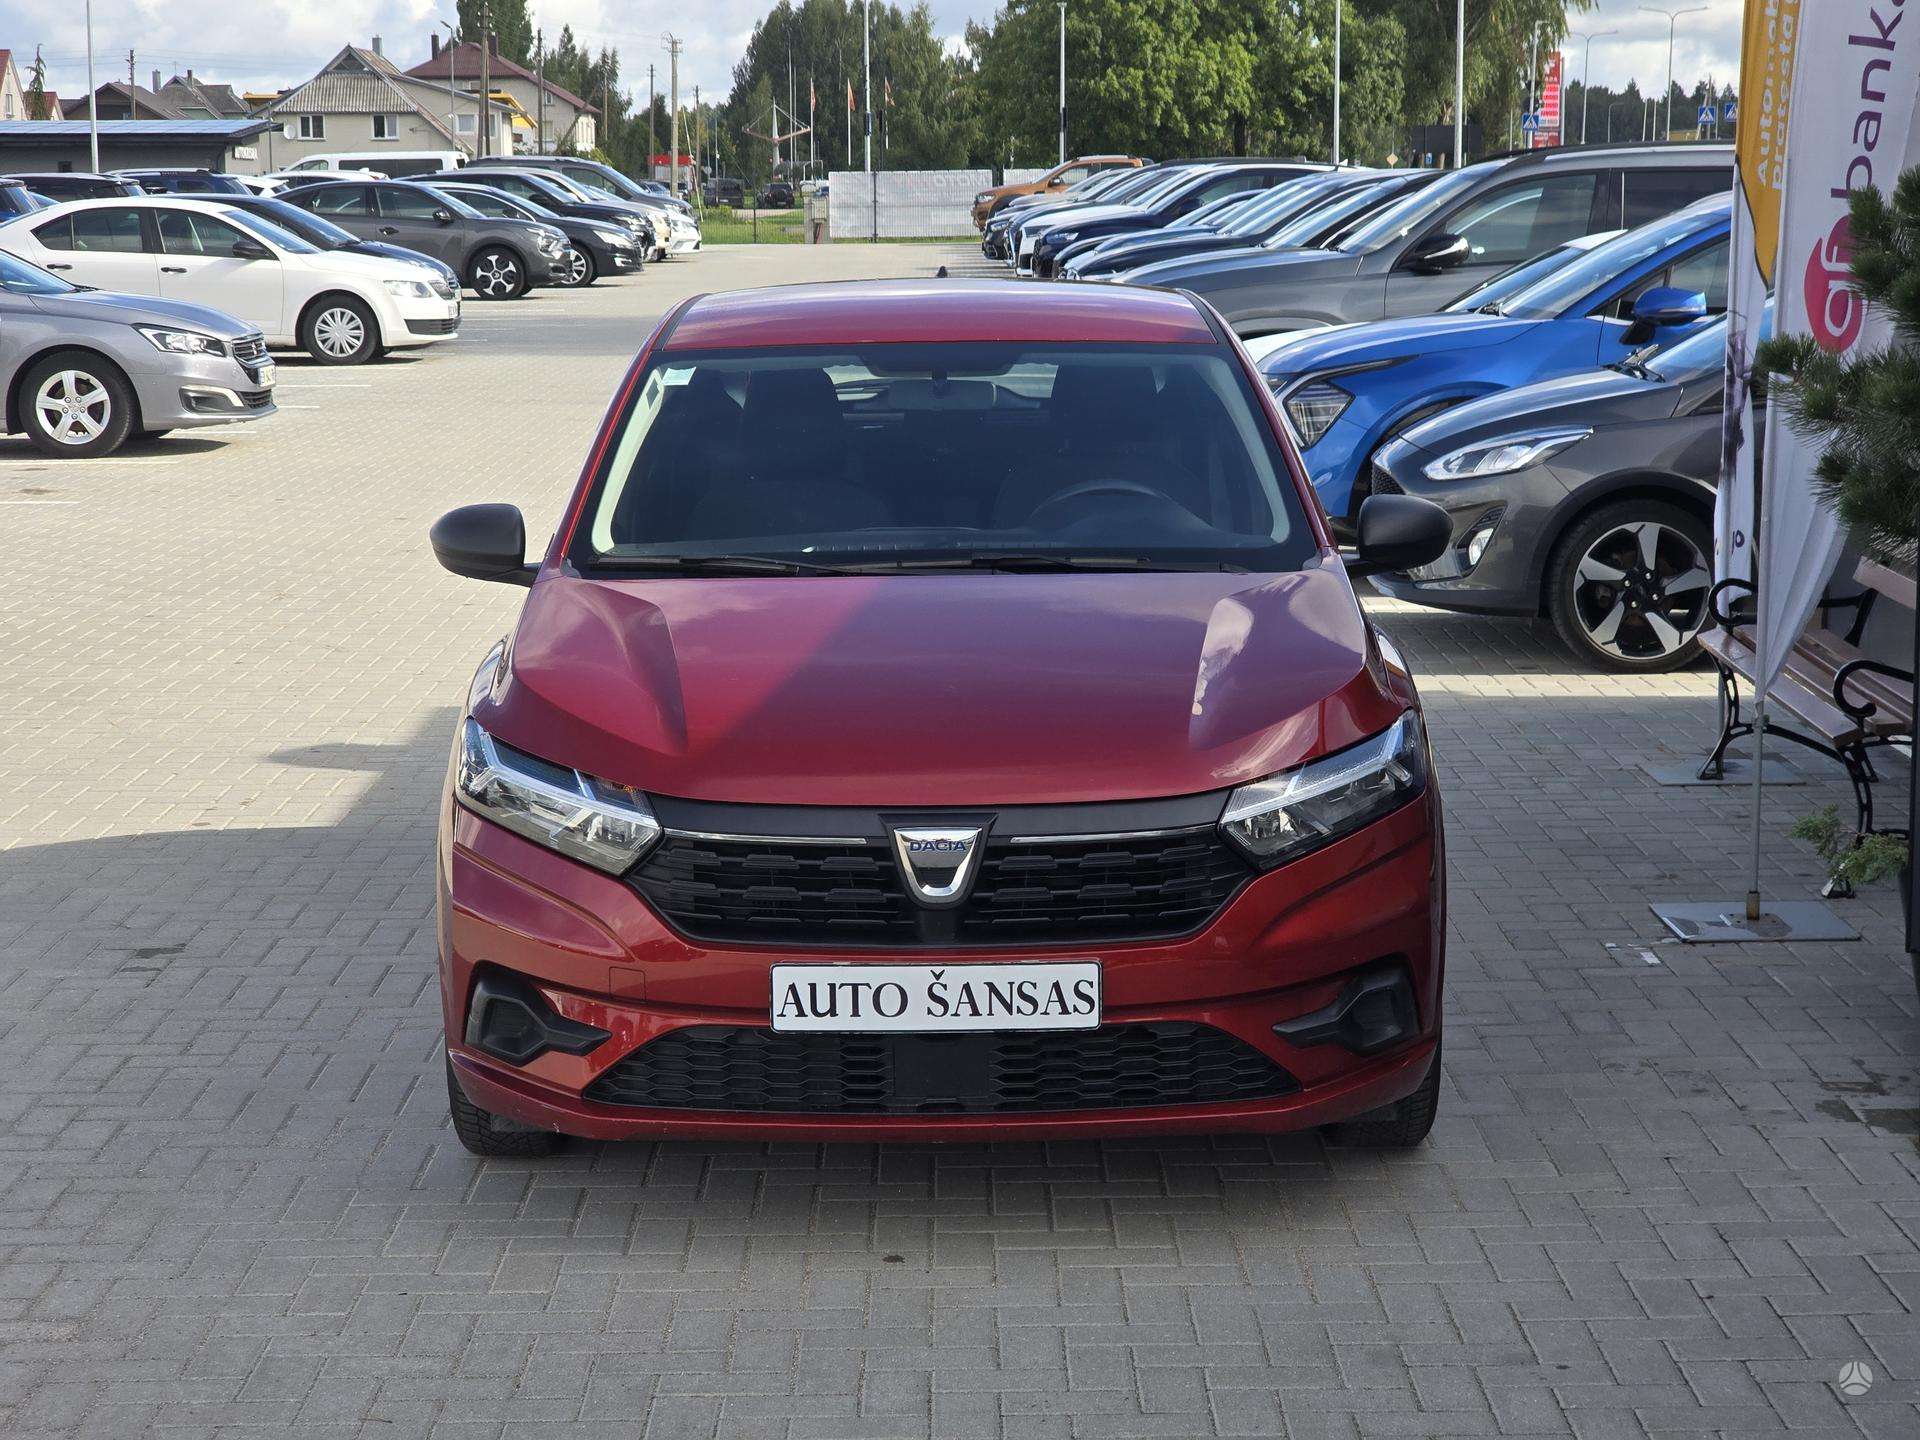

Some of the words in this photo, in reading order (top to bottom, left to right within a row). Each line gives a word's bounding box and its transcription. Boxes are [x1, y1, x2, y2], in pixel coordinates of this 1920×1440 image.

[1831, 0, 1905, 199] bank
[909, 840, 967, 851] DACIA
[777, 982, 909, 1018] AUTO
[926, 969, 1096, 1016] ŠANSAS
